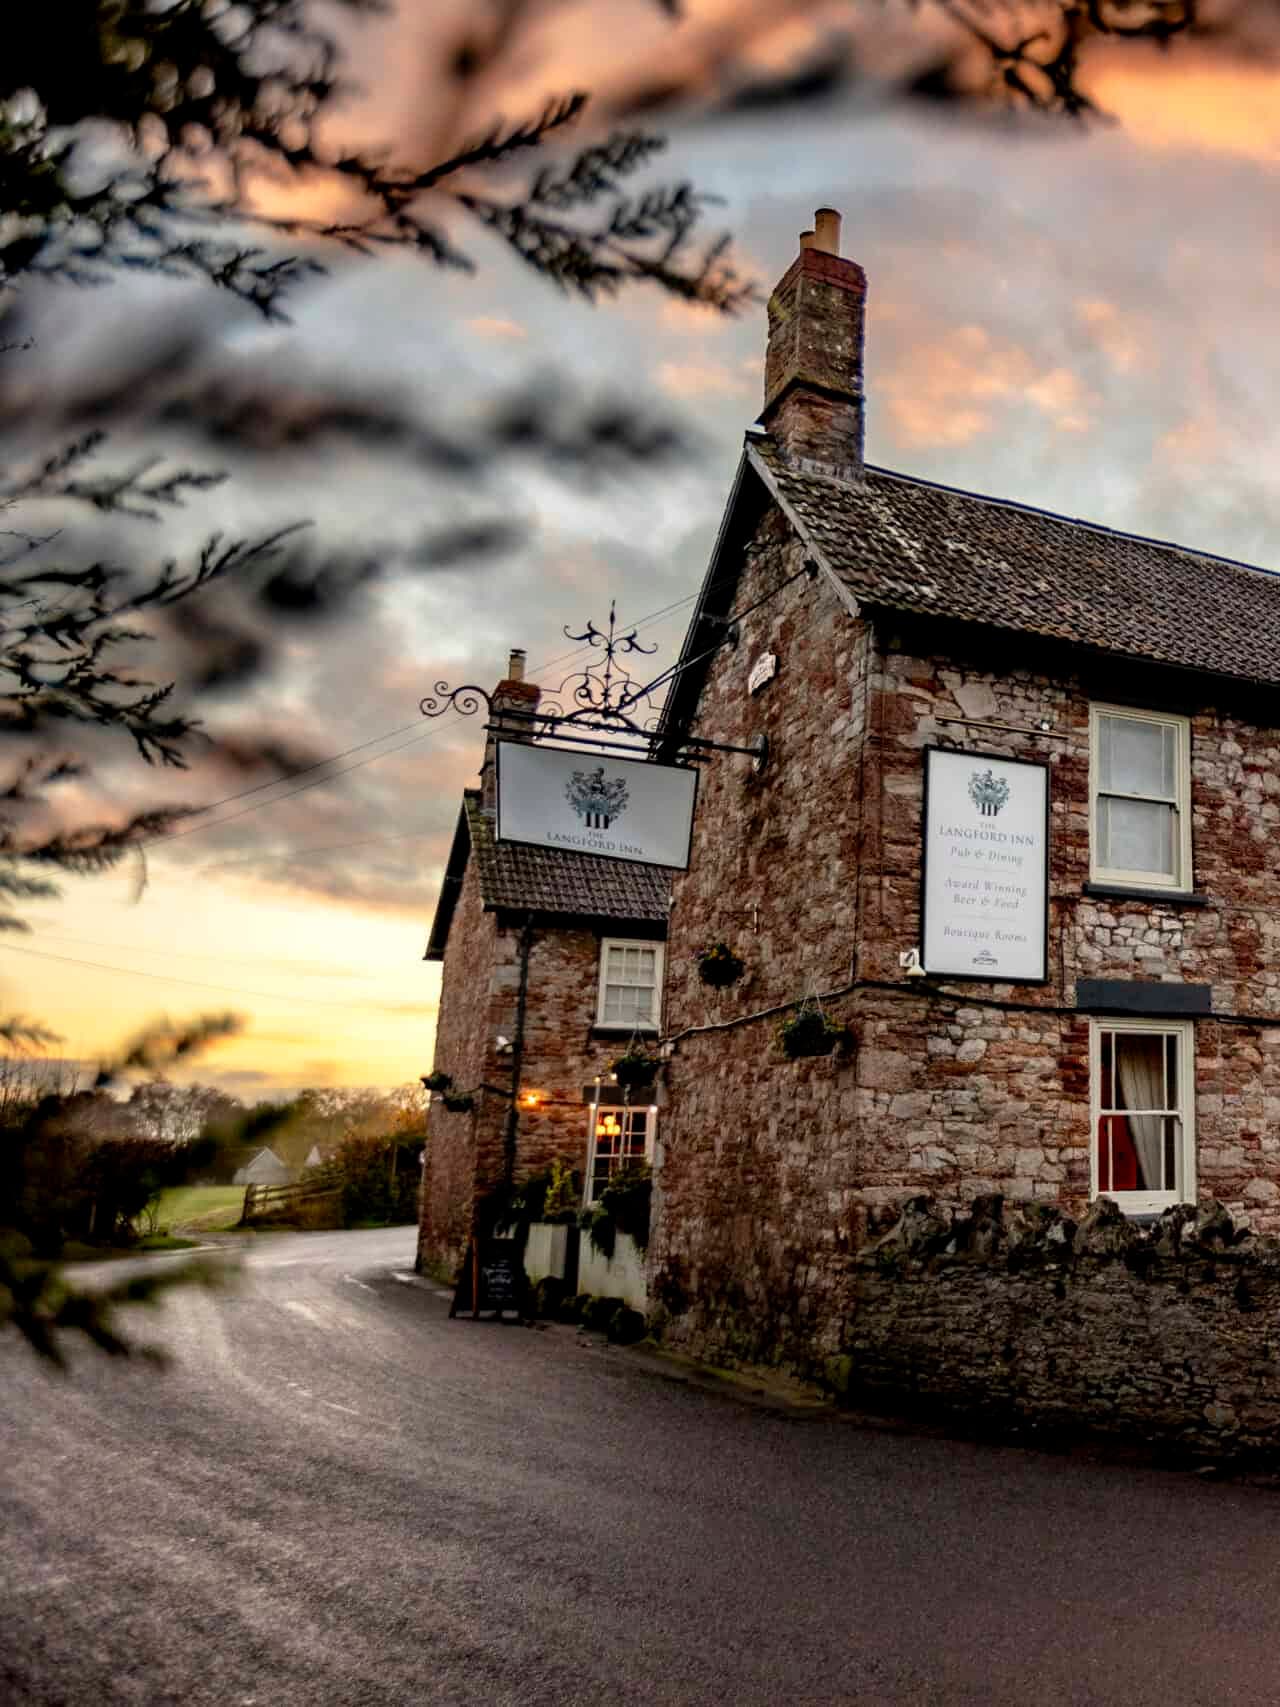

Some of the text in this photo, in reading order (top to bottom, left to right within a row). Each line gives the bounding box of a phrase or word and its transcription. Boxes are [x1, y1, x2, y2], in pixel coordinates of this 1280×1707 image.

[547, 831, 643, 855] LANGFORD INN
[939, 824, 1035, 846] LANGFORD INN
[951, 846, 1023, 866] Pub & Dining
[944, 877, 1027, 897] Award Winning
[953, 895, 1019, 909] Beer & Food
[944, 926, 1027, 942] Boutique Rooms
